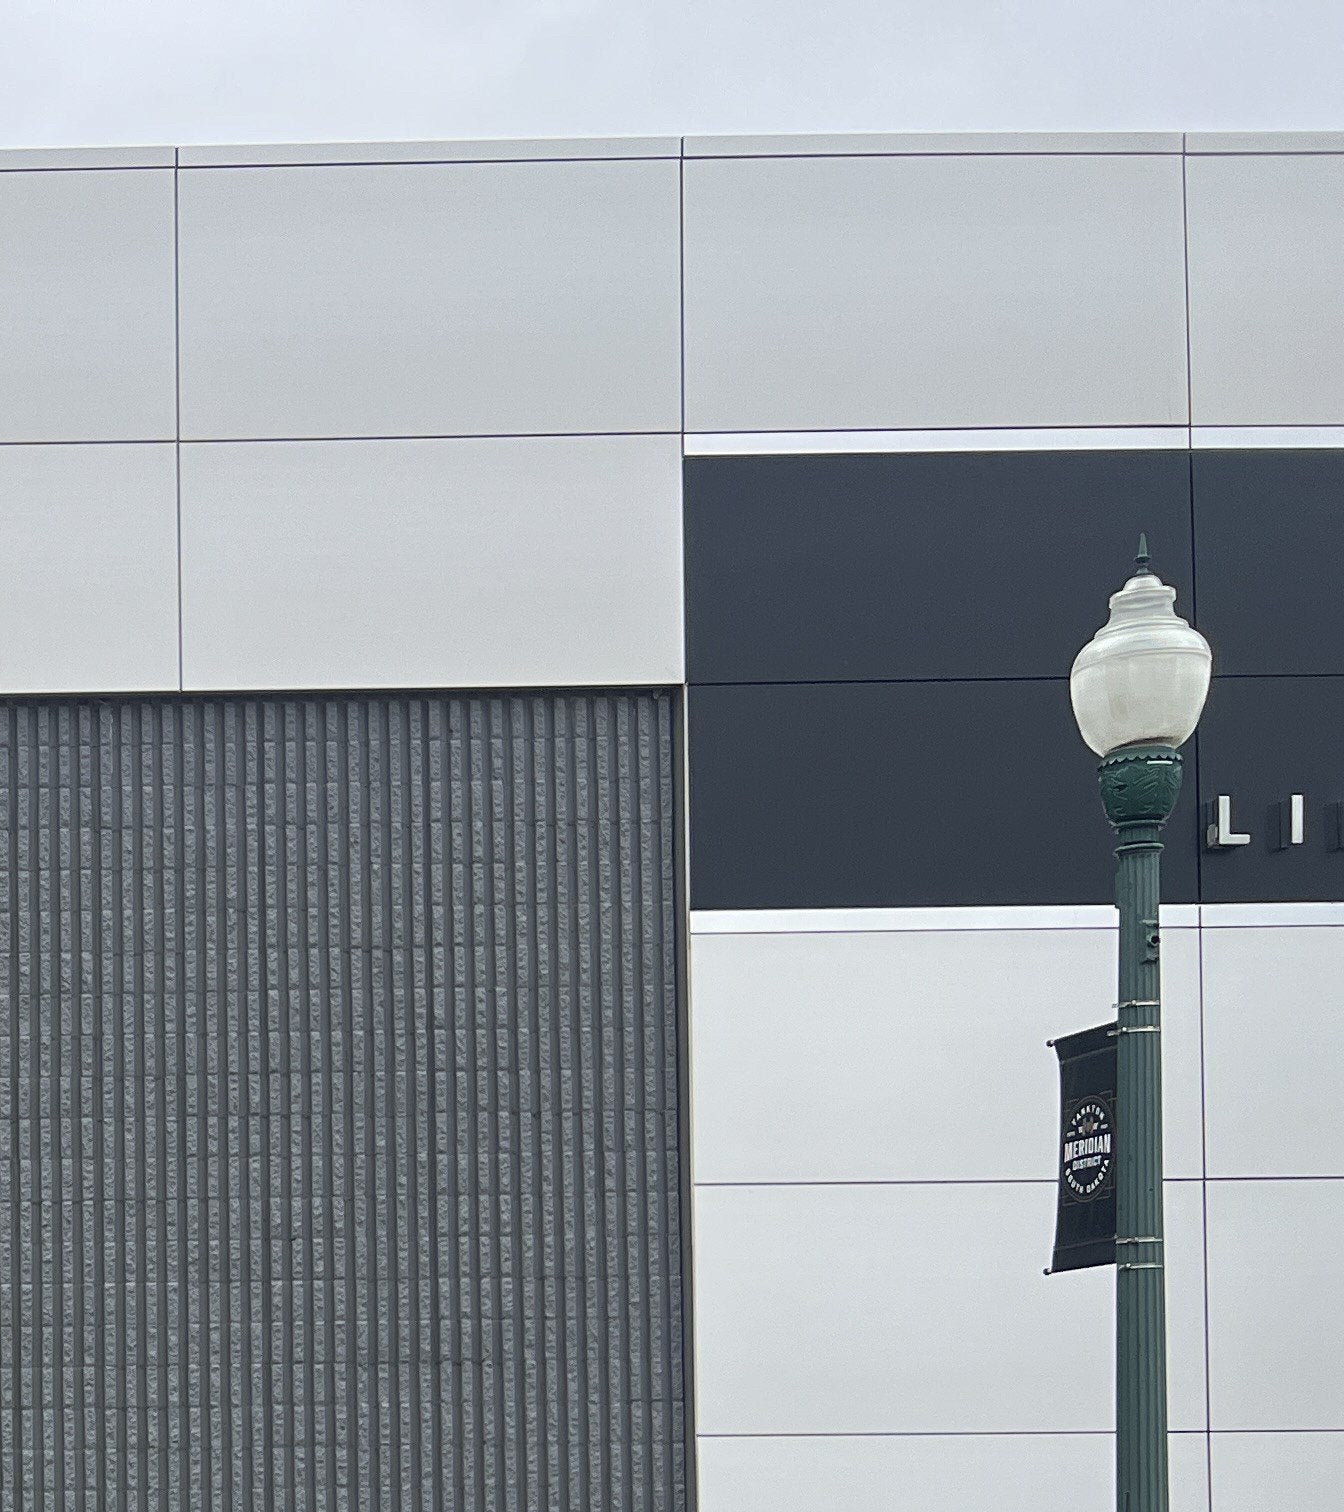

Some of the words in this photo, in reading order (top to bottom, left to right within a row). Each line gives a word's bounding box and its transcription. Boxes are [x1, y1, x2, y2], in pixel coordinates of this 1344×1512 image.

[1064, 1134, 1111, 1163] MERIDIAN
[1073, 1156, 1102, 1171] DISTRICT
[1086, 1159, 1109, 1193] DAKOTA
